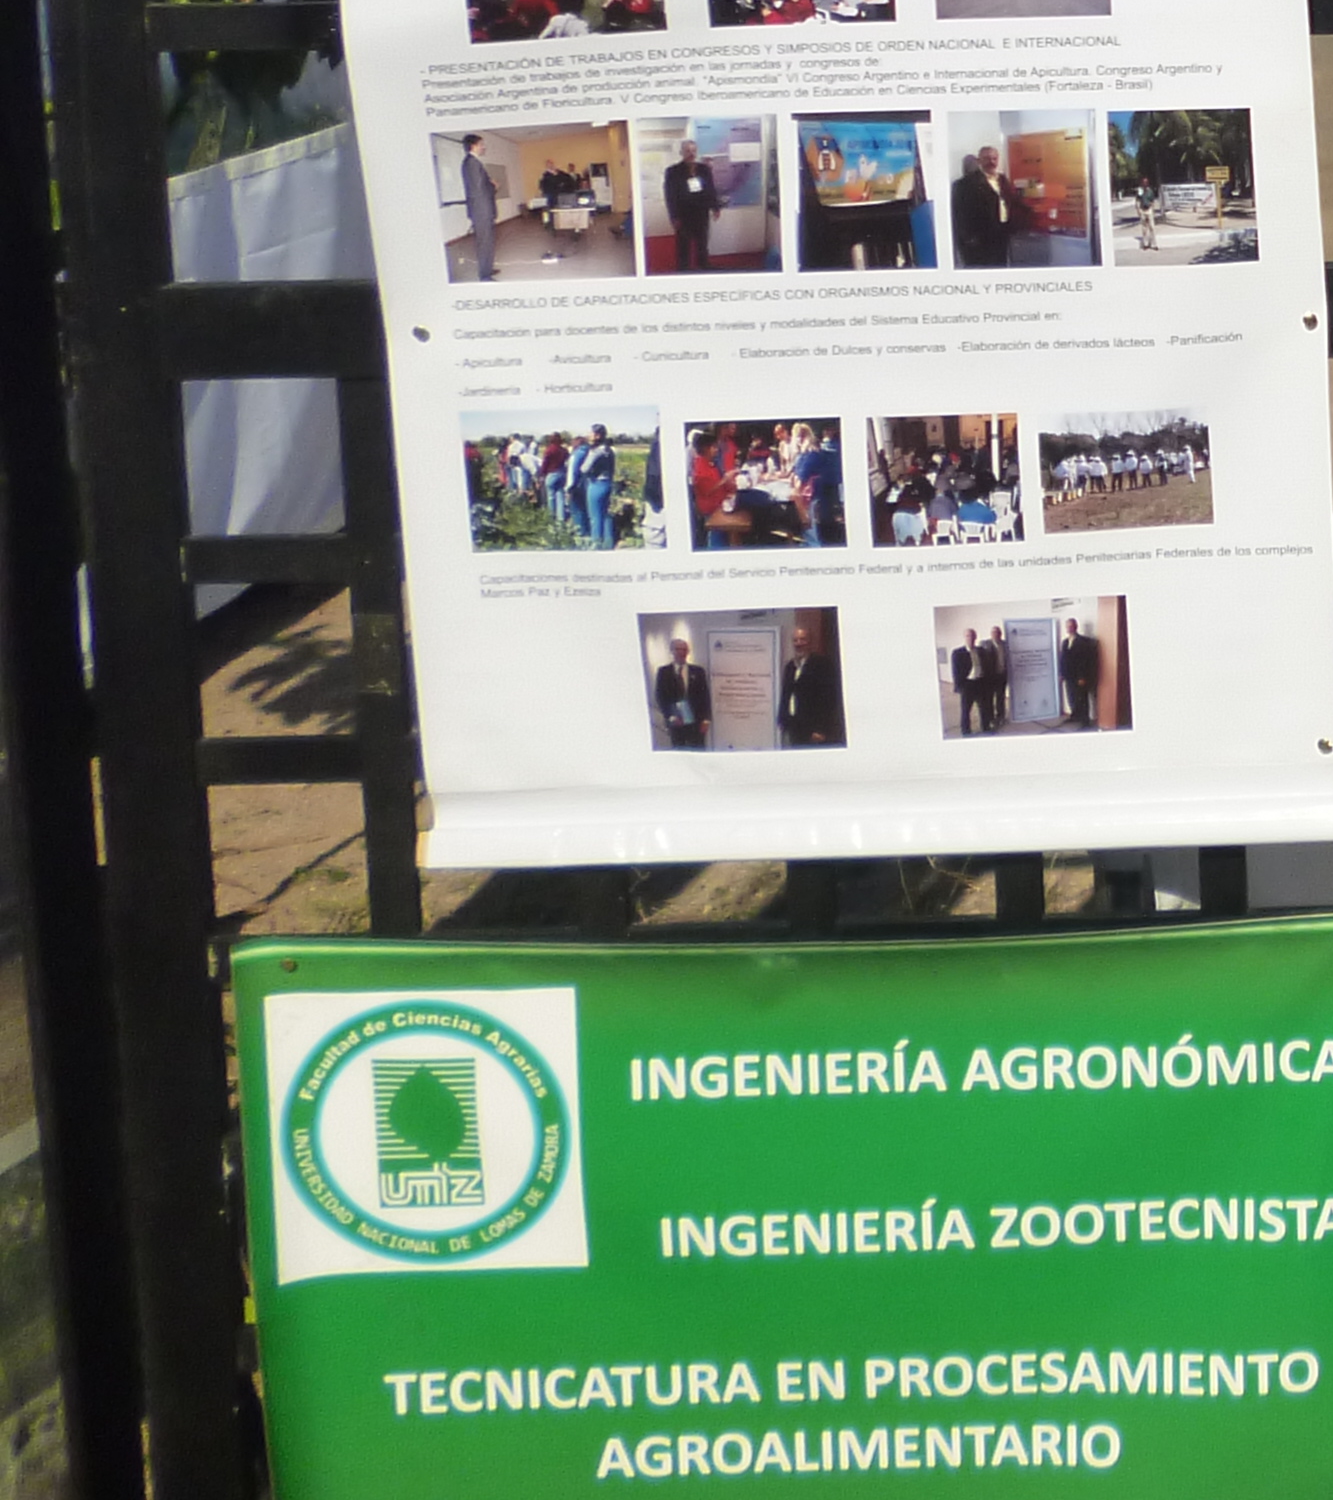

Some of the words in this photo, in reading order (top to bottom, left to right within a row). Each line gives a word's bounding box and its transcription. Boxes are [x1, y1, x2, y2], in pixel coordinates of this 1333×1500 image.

[427, 55, 542, 76] PRESENTACIÓN
[544, 56, 564, 69] DE
[567, 51, 644, 67] TRABAJOS
[647, 49, 667, 62] EN
[670, 44, 760, 61] CONGRESOS
[763, 44, 772, 56] Y
[776, 41, 851, 55] SIMPOSIOS
[854, 40, 873, 52] DE
[877, 39, 925, 52] ORDEN
[927, 38, 995, 51] NACIONAL
[1001, 38, 1011, 49] E
[1014, 36, 1120, 49] INTERNACIONAL
[550, 296, 568, 308] DE
[572, 291, 689, 307] CAPACITACIONES
[692, 286, 780, 303] ESPECÍFICAS
[783, 287, 814, 300] CON
[817, 285, 909, 299] ORGANISMOS
[912, 283, 979, 297] NACIONAL
[982, 283, 991, 295] Y
[994, 281, 1092, 295] PROVINCIALES
[299, 1030, 361, 1100] Facultad
[363, 1019, 387, 1037] de
[392, 1011, 482, 1035] Ciencias
[485, 1031, 548, 1099] Agrarias
[631, 1040, 946, 1100] INGENIERÍA
[293, 1128, 354, 1225] UNIVERSIDAD
[357, 1222, 439, 1254] NACIONAL
[449, 1236, 471, 1252] DE
[479, 1207, 526, 1242] LOMAS
[524, 1188, 545, 1208] DE
[537, 1124, 560, 1184] ZAMORA
[661, 1199, 975, 1256] INGENIERÍA
[384, 1363, 760, 1414] TECNICATURA
[777, 1361, 845, 1401] EN
[865, 1351, 1318, 1398] PROCESAMIENTO
[597, 1425, 1120, 1478] AGROALIMENTARIO
